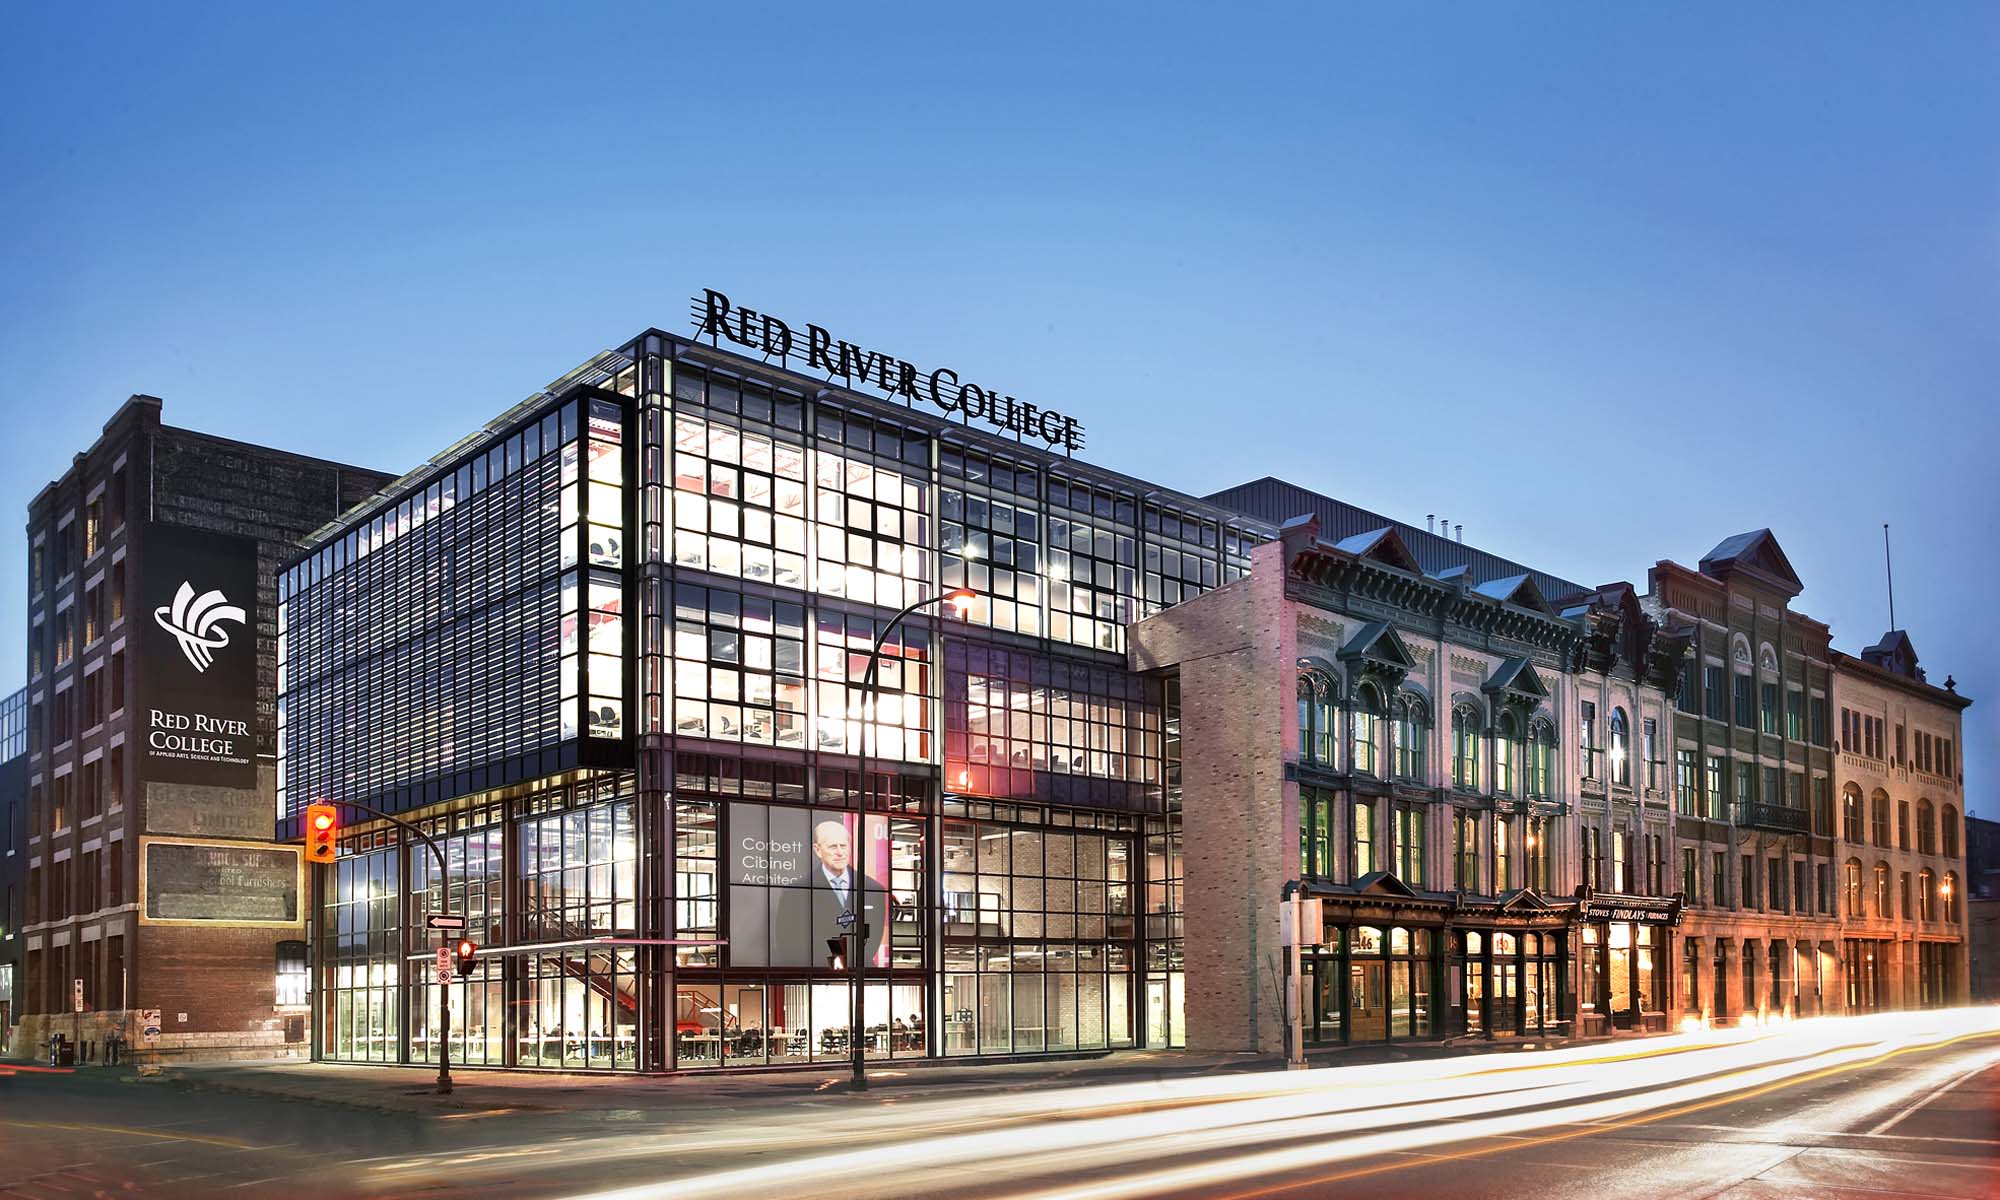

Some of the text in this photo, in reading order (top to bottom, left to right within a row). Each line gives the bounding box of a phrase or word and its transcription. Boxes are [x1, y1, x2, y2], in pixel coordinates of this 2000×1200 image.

[702, 287, 1079, 451] RED RIVER COLLEGE
[150, 709, 250, 736] RED RIVER
[149, 731, 233, 755] COLLEGE
[190, 753, 210, 761] SCIENCE
[220, 756, 249, 764] TECHNOLOGY
[742, 837, 803, 854] Corbett
[742, 855, 796, 871] Cibinel
[742, 872, 803, 886] Architec
[1588, 908, 1669, 920] STOVES FINDLAYS FURNACES
